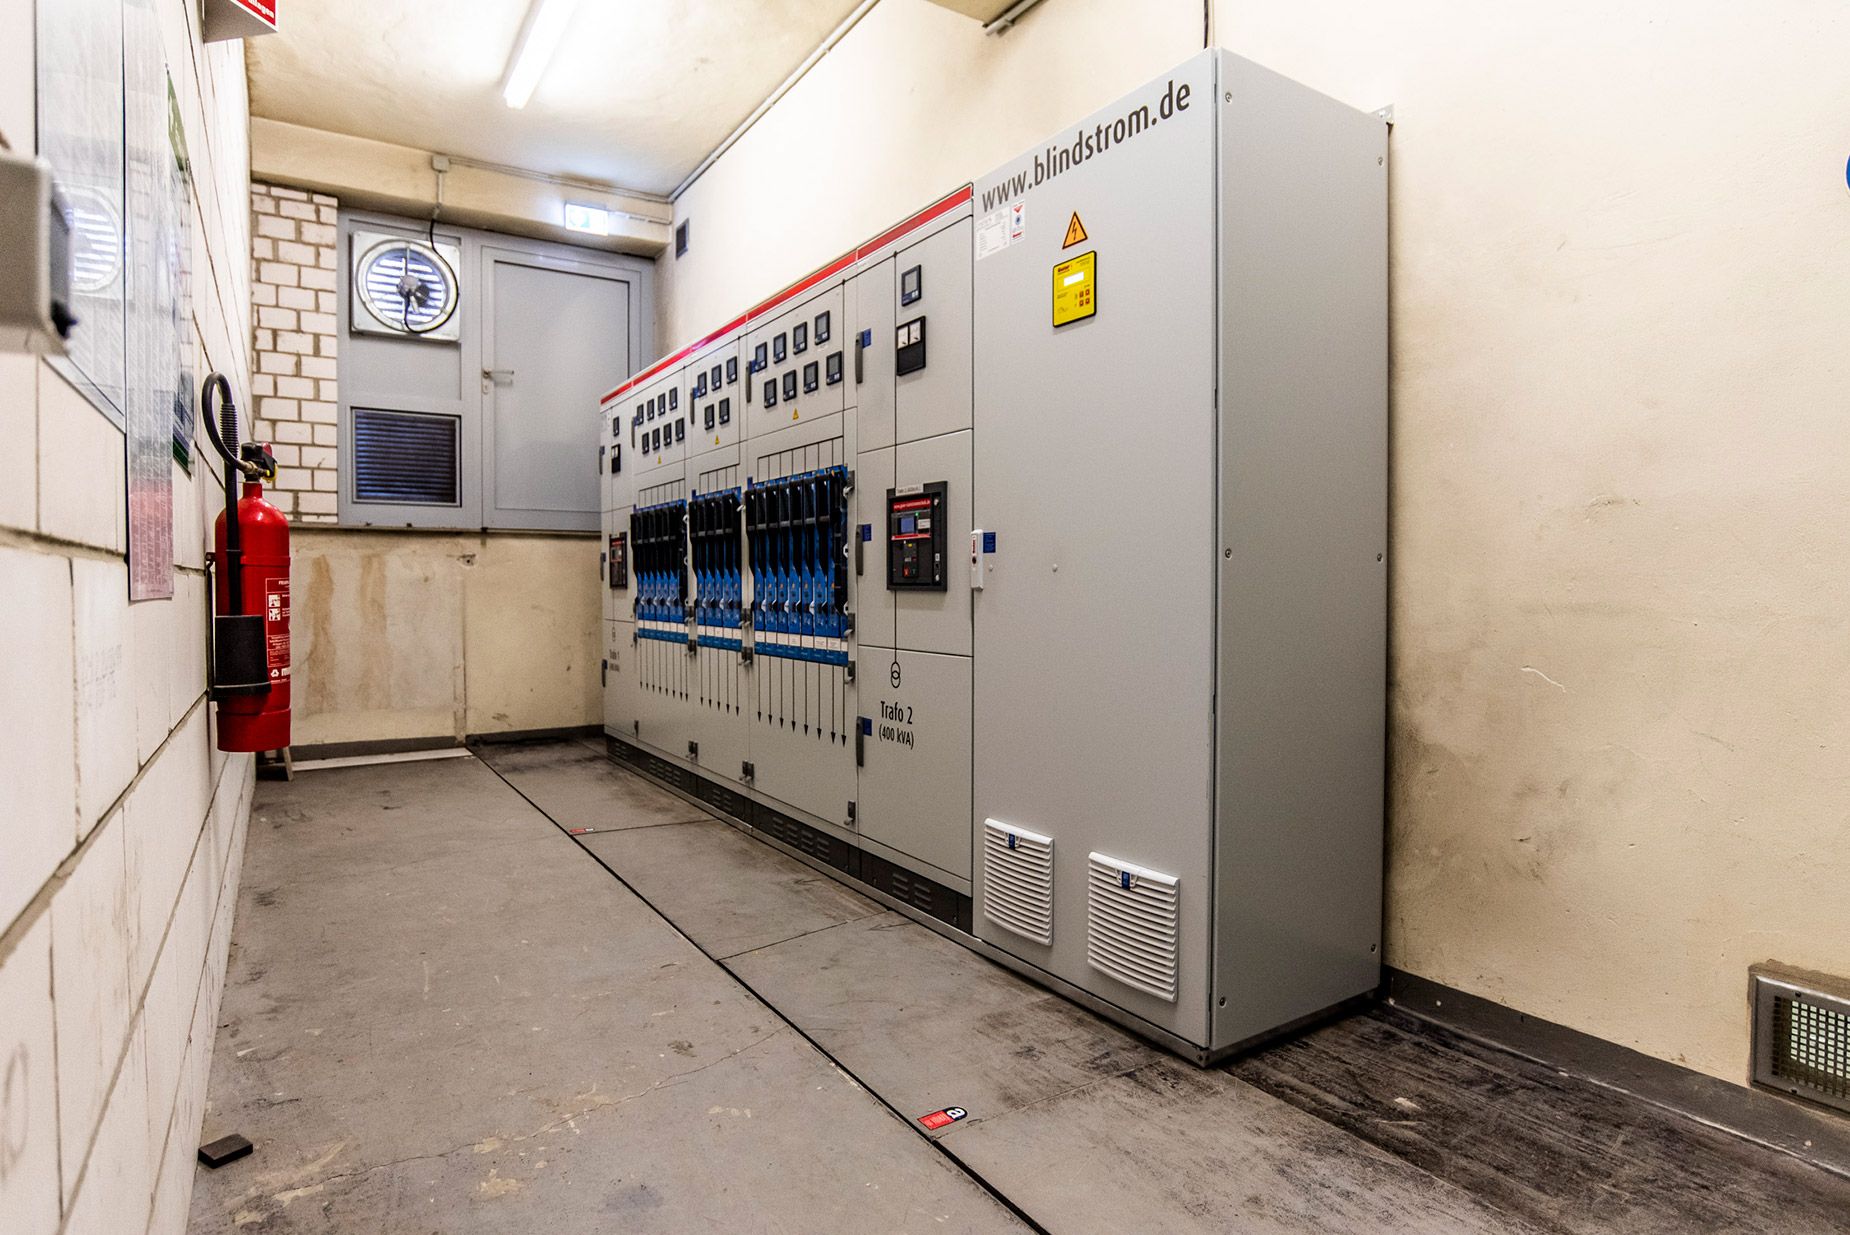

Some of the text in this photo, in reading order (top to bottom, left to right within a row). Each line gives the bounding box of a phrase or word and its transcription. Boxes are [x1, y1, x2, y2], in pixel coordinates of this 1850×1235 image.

[982, 80, 1191, 213] www.blindstrom.de
[880, 700, 913, 725] Trafo 2
[878, 723, 915, 750] (400 kVA)
